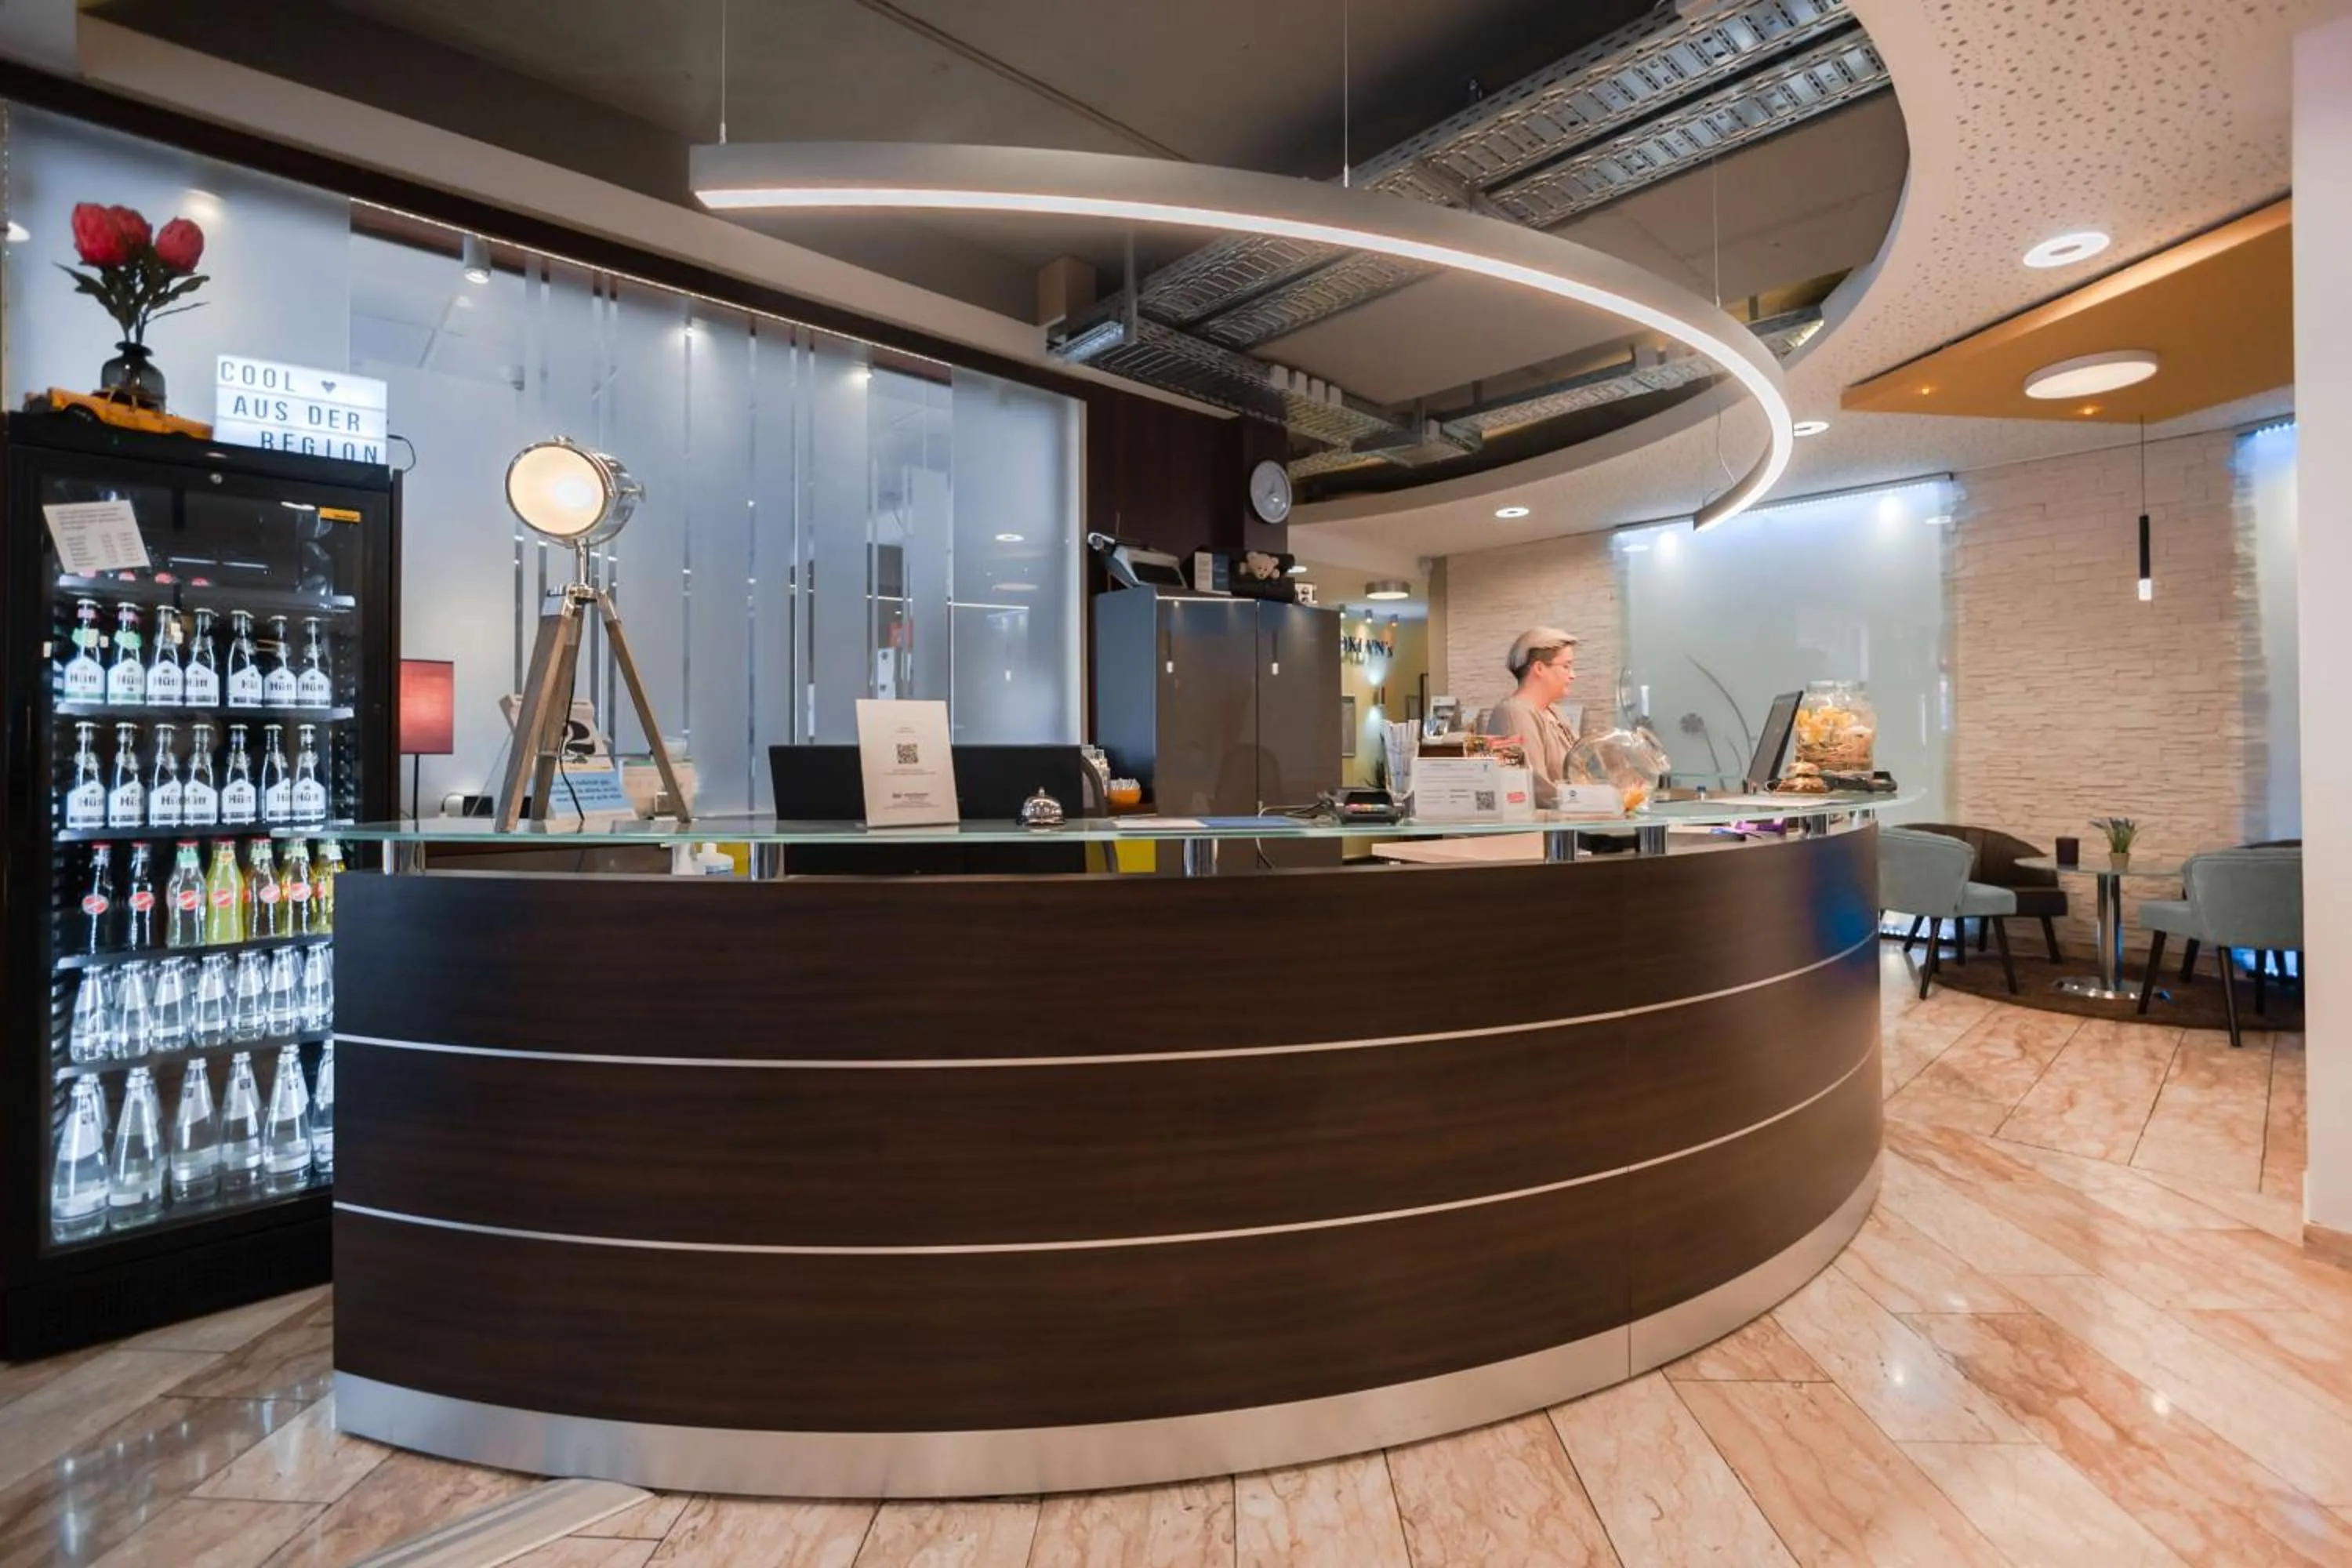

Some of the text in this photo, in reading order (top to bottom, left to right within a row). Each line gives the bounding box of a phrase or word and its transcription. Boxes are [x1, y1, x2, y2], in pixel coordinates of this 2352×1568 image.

[220, 361, 296, 392] COOL
[233, 395, 360, 432] AUS DER
[260, 430, 377, 464] REGION
